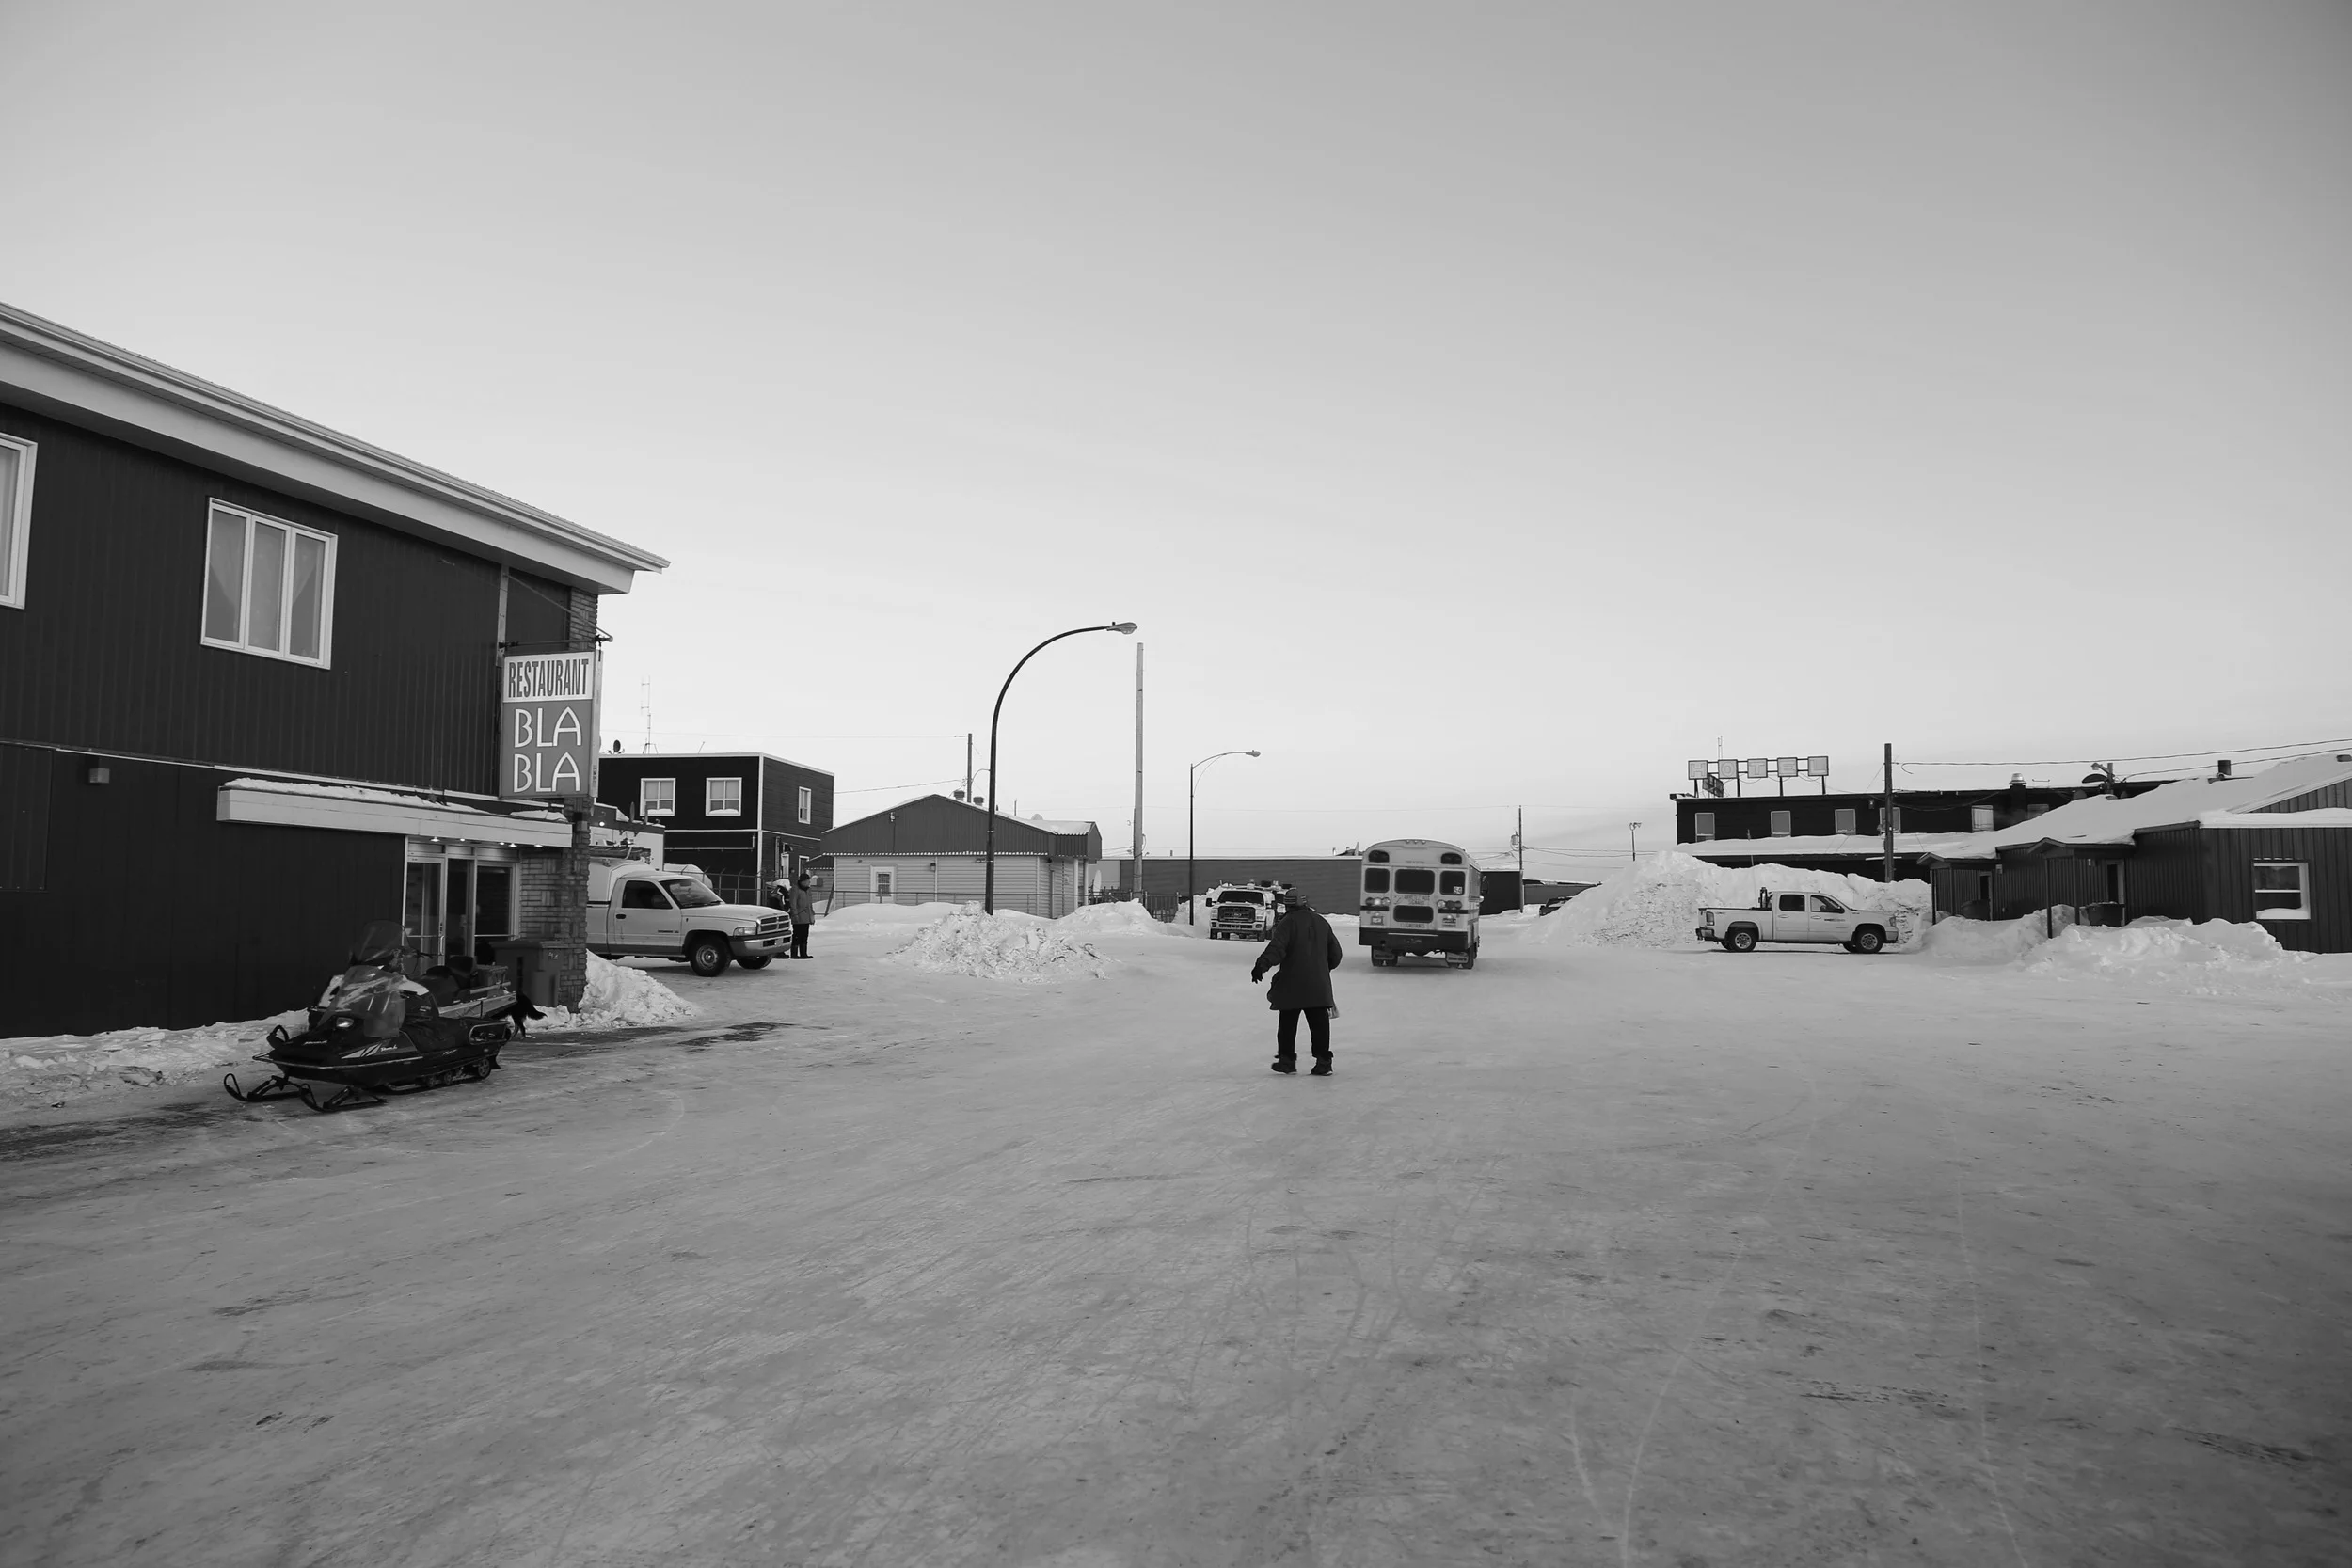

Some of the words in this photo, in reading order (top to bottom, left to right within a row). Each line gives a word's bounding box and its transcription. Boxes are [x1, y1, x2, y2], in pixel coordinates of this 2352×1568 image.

[508, 658, 589, 698] RESTAURANT
[514, 706, 582, 748] BLA
[513, 752, 580, 793] BLA
[1690, 758, 1827, 779] HOTEL
